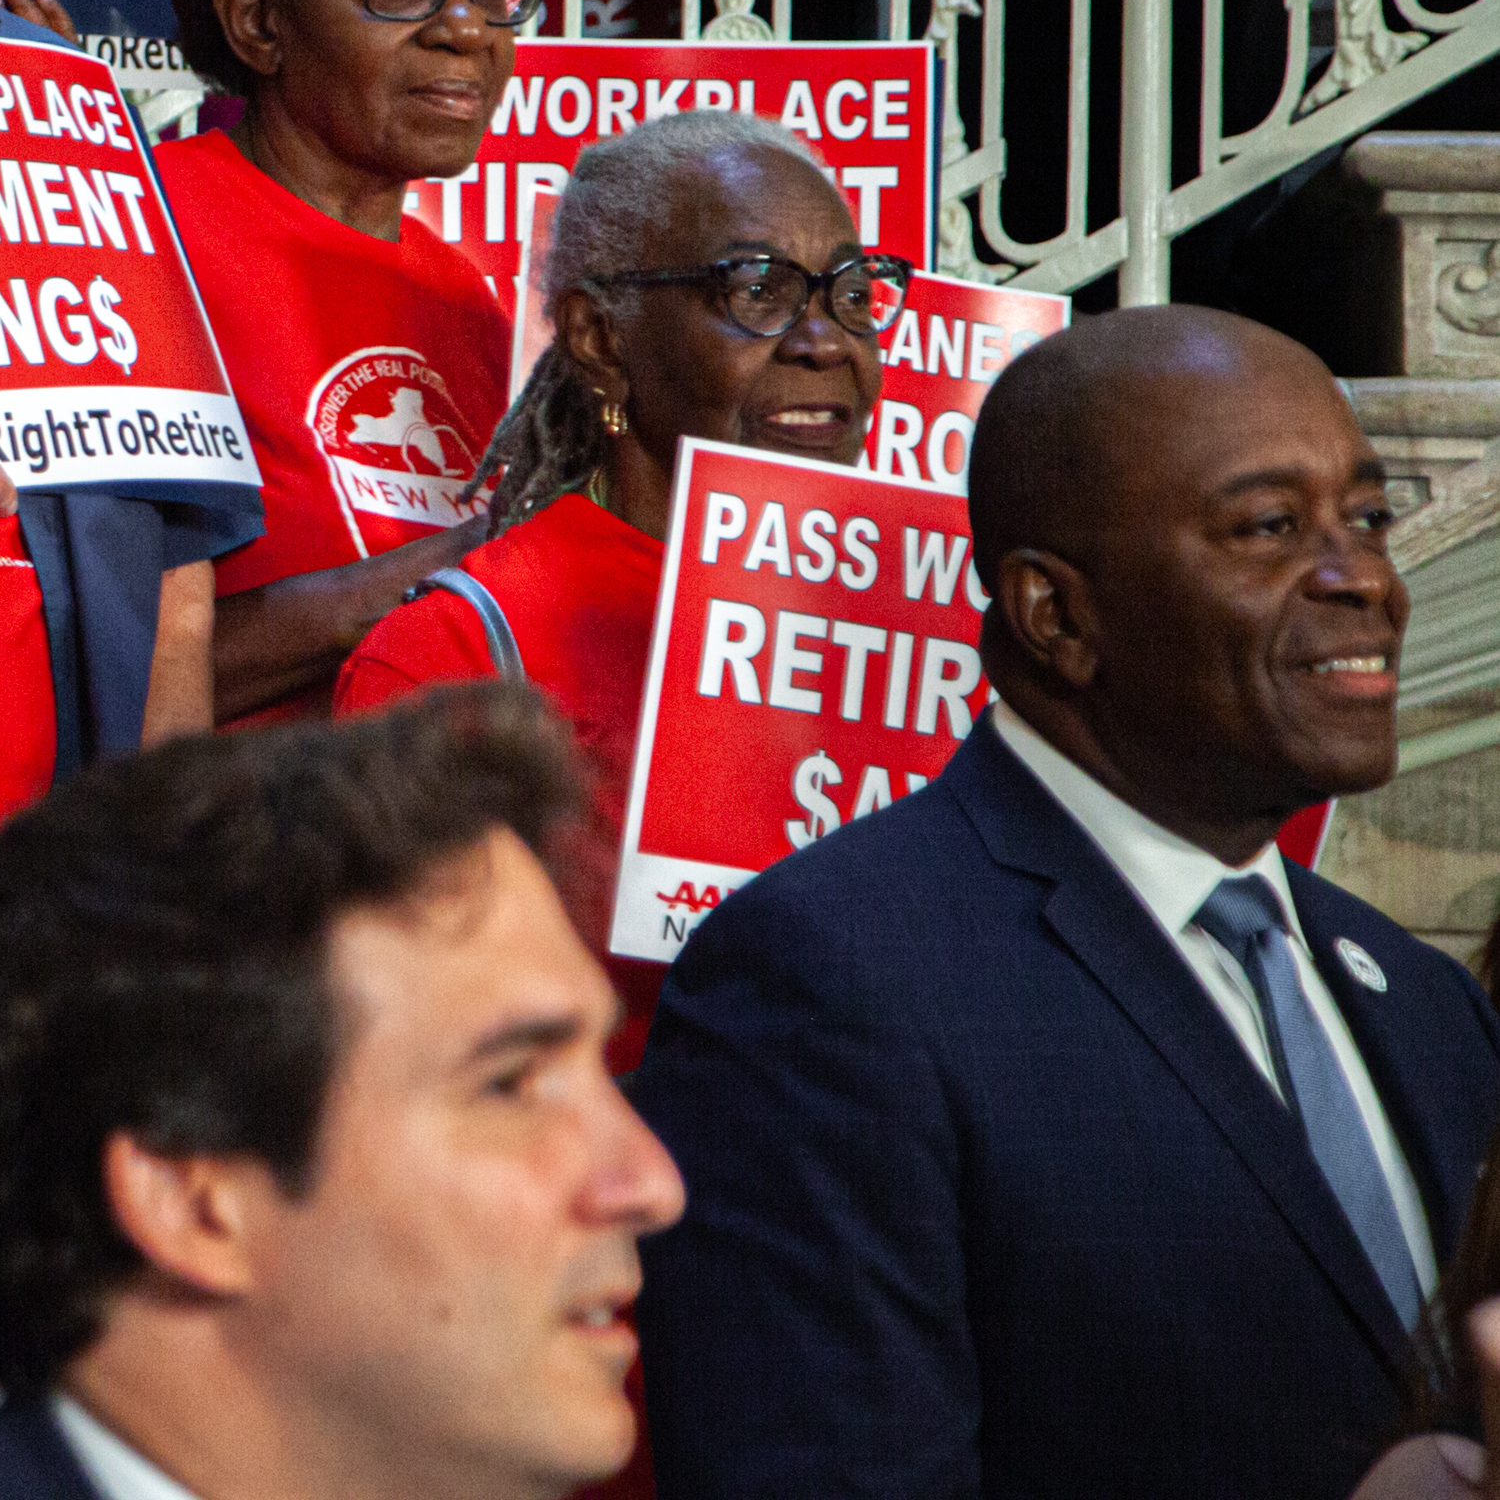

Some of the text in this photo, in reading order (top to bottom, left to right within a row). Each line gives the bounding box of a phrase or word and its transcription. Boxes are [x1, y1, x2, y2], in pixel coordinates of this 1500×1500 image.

[342, 360, 378, 392] THE
[351, 473, 431, 513] NEW
[701, 490, 880, 591] PASS
[698, 597, 985, 741] RETIR
